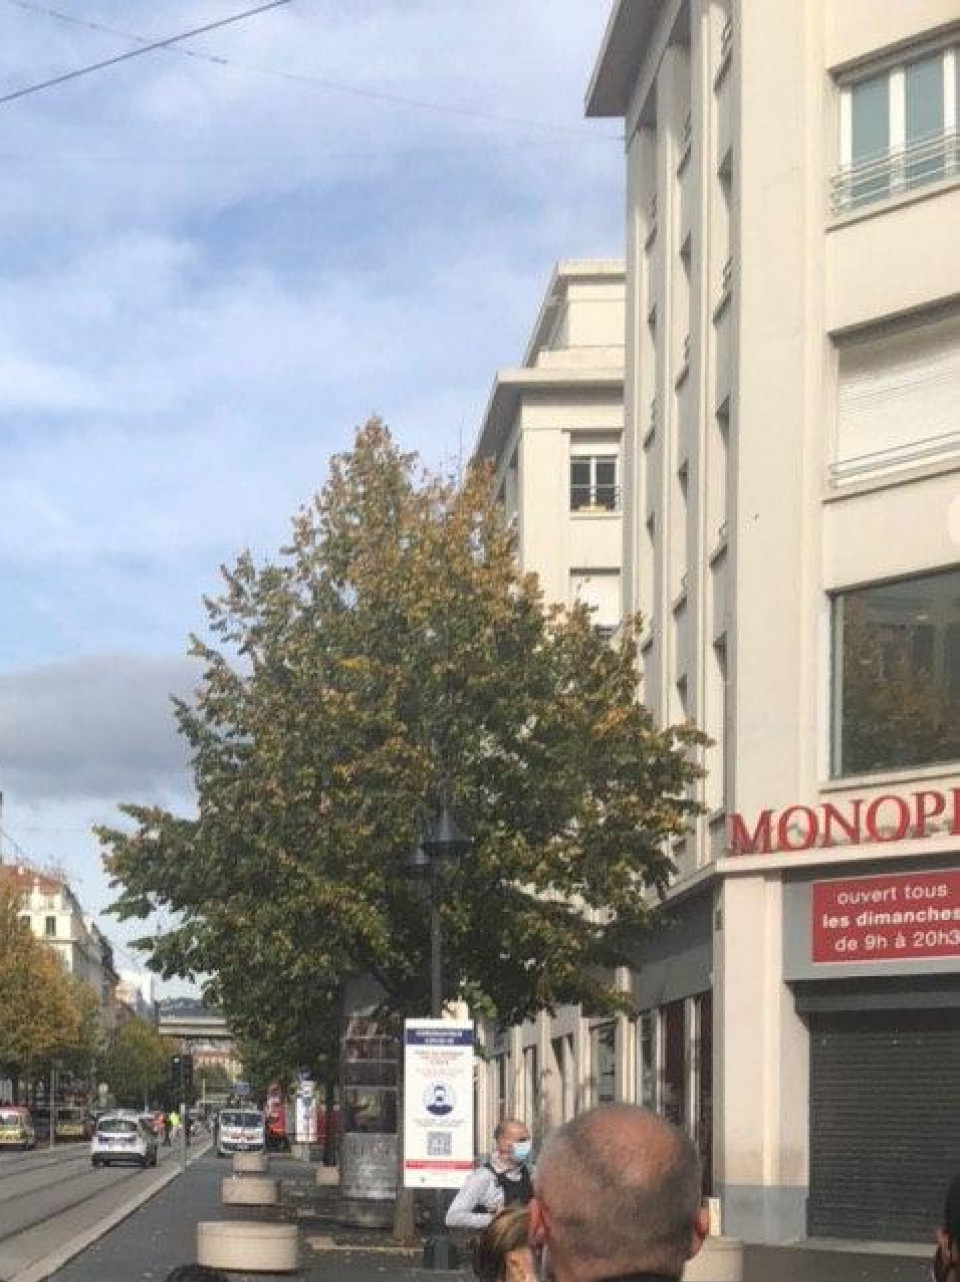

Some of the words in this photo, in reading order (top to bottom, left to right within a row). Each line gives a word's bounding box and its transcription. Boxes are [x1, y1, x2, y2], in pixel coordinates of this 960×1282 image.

[728, 788, 960, 856] MONOP
[837, 886, 897, 905] ouvert
[904, 883, 948, 900] tous
[823, 913, 850, 929] les
[856, 906, 960, 927] dimanches
[835, 936, 858, 952] de
[865, 934, 887, 950] 9h
